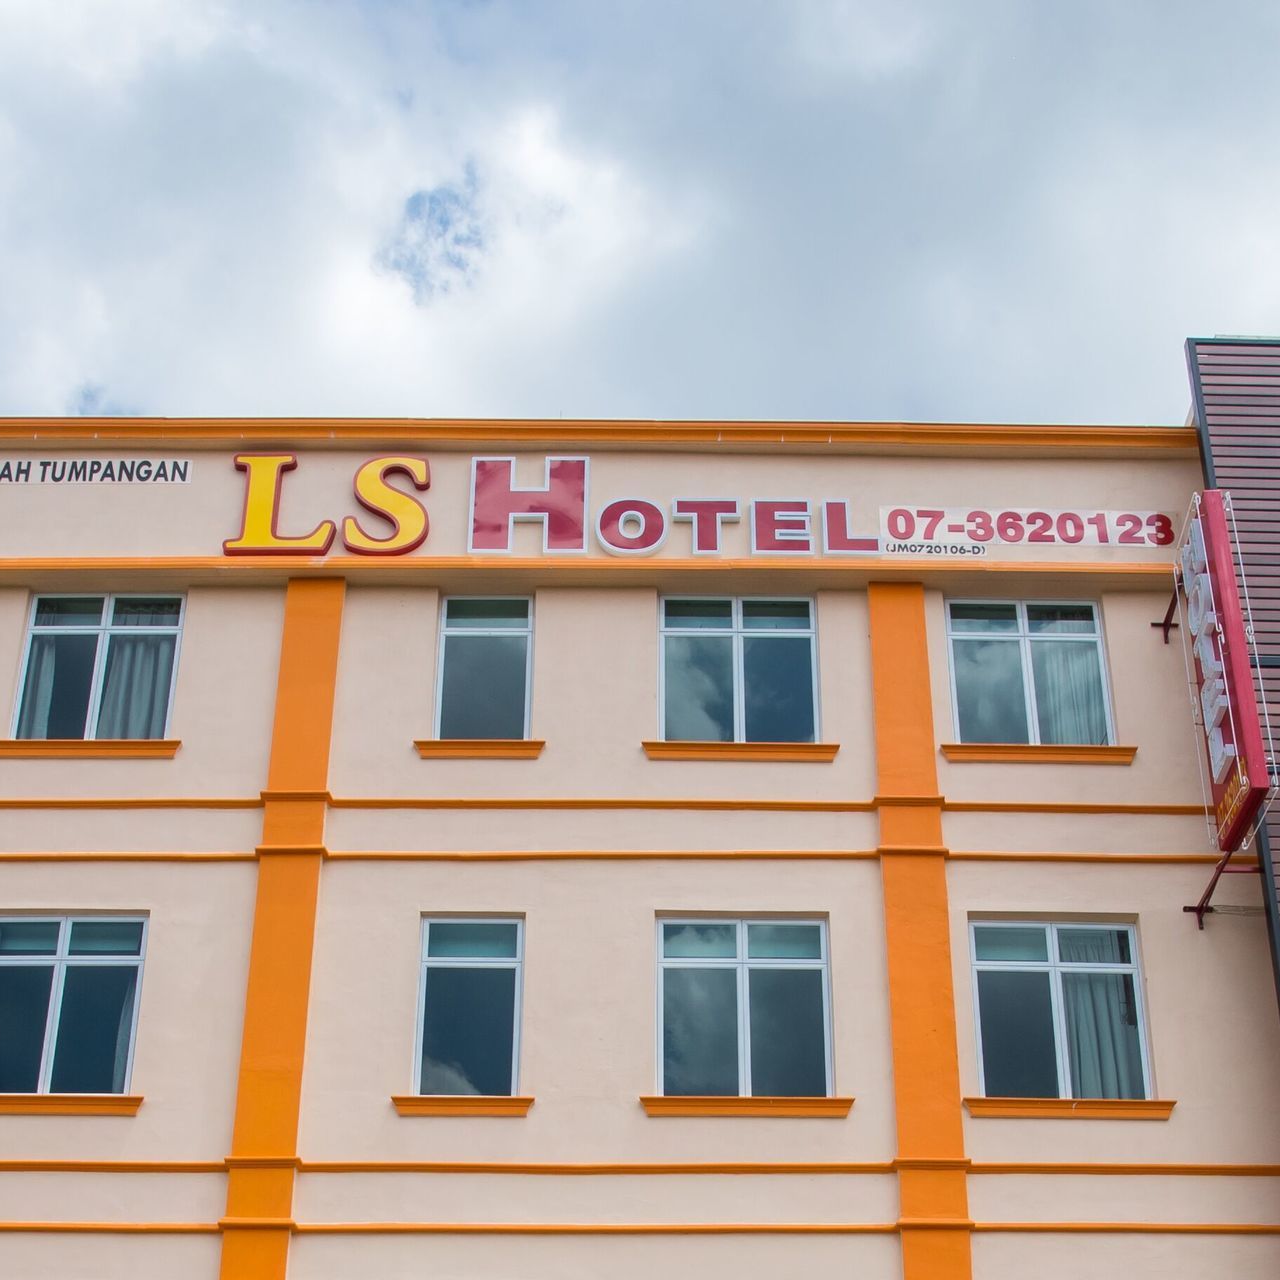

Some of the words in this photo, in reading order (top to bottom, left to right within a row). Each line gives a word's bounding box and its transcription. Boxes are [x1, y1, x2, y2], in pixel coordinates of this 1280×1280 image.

[39, 460, 189, 483] TUMPANGAN
[222, 452, 431, 557] LS
[467, 456, 881, 557] HOTEL
[887, 508, 1175, 545] 07-3620123
[886, 543, 986, 555] (JM0720106-D)
